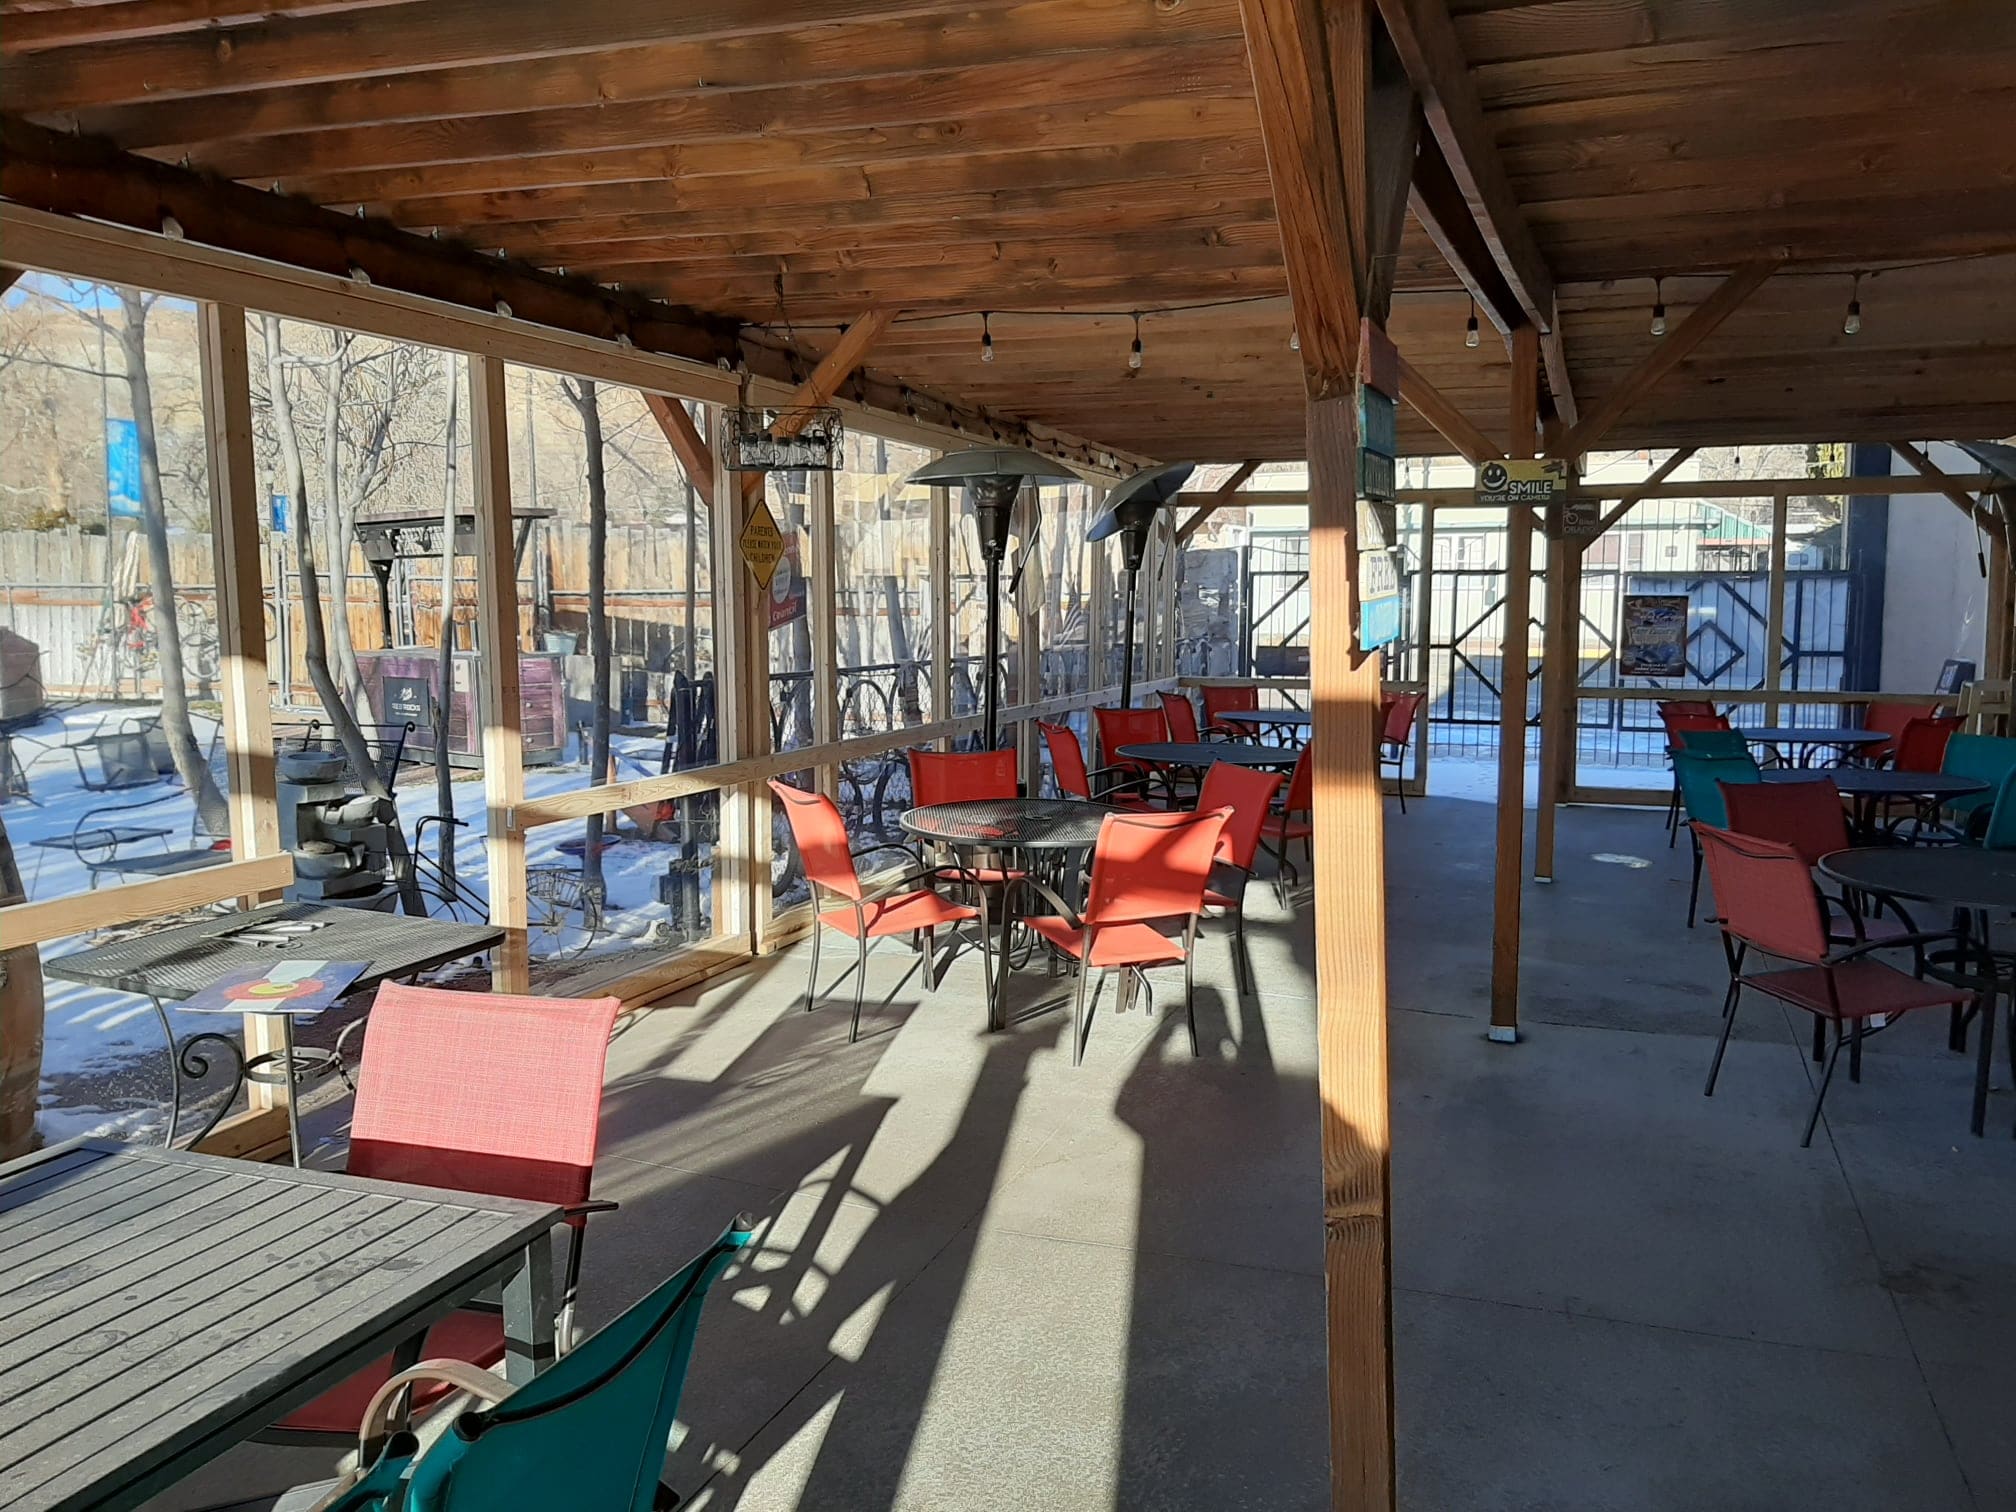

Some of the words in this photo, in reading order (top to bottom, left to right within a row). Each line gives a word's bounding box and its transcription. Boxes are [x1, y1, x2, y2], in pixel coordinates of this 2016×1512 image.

[1509, 482, 1552, 494] SMILE
[1480, 494, 1507, 502] YOU'RE
[1507, 494, 1519, 502] ON
[1520, 493, 1551, 501] CAMERA
[750, 525, 774, 537] PARENTS
[750, 552, 775, 563] CHILDREN
